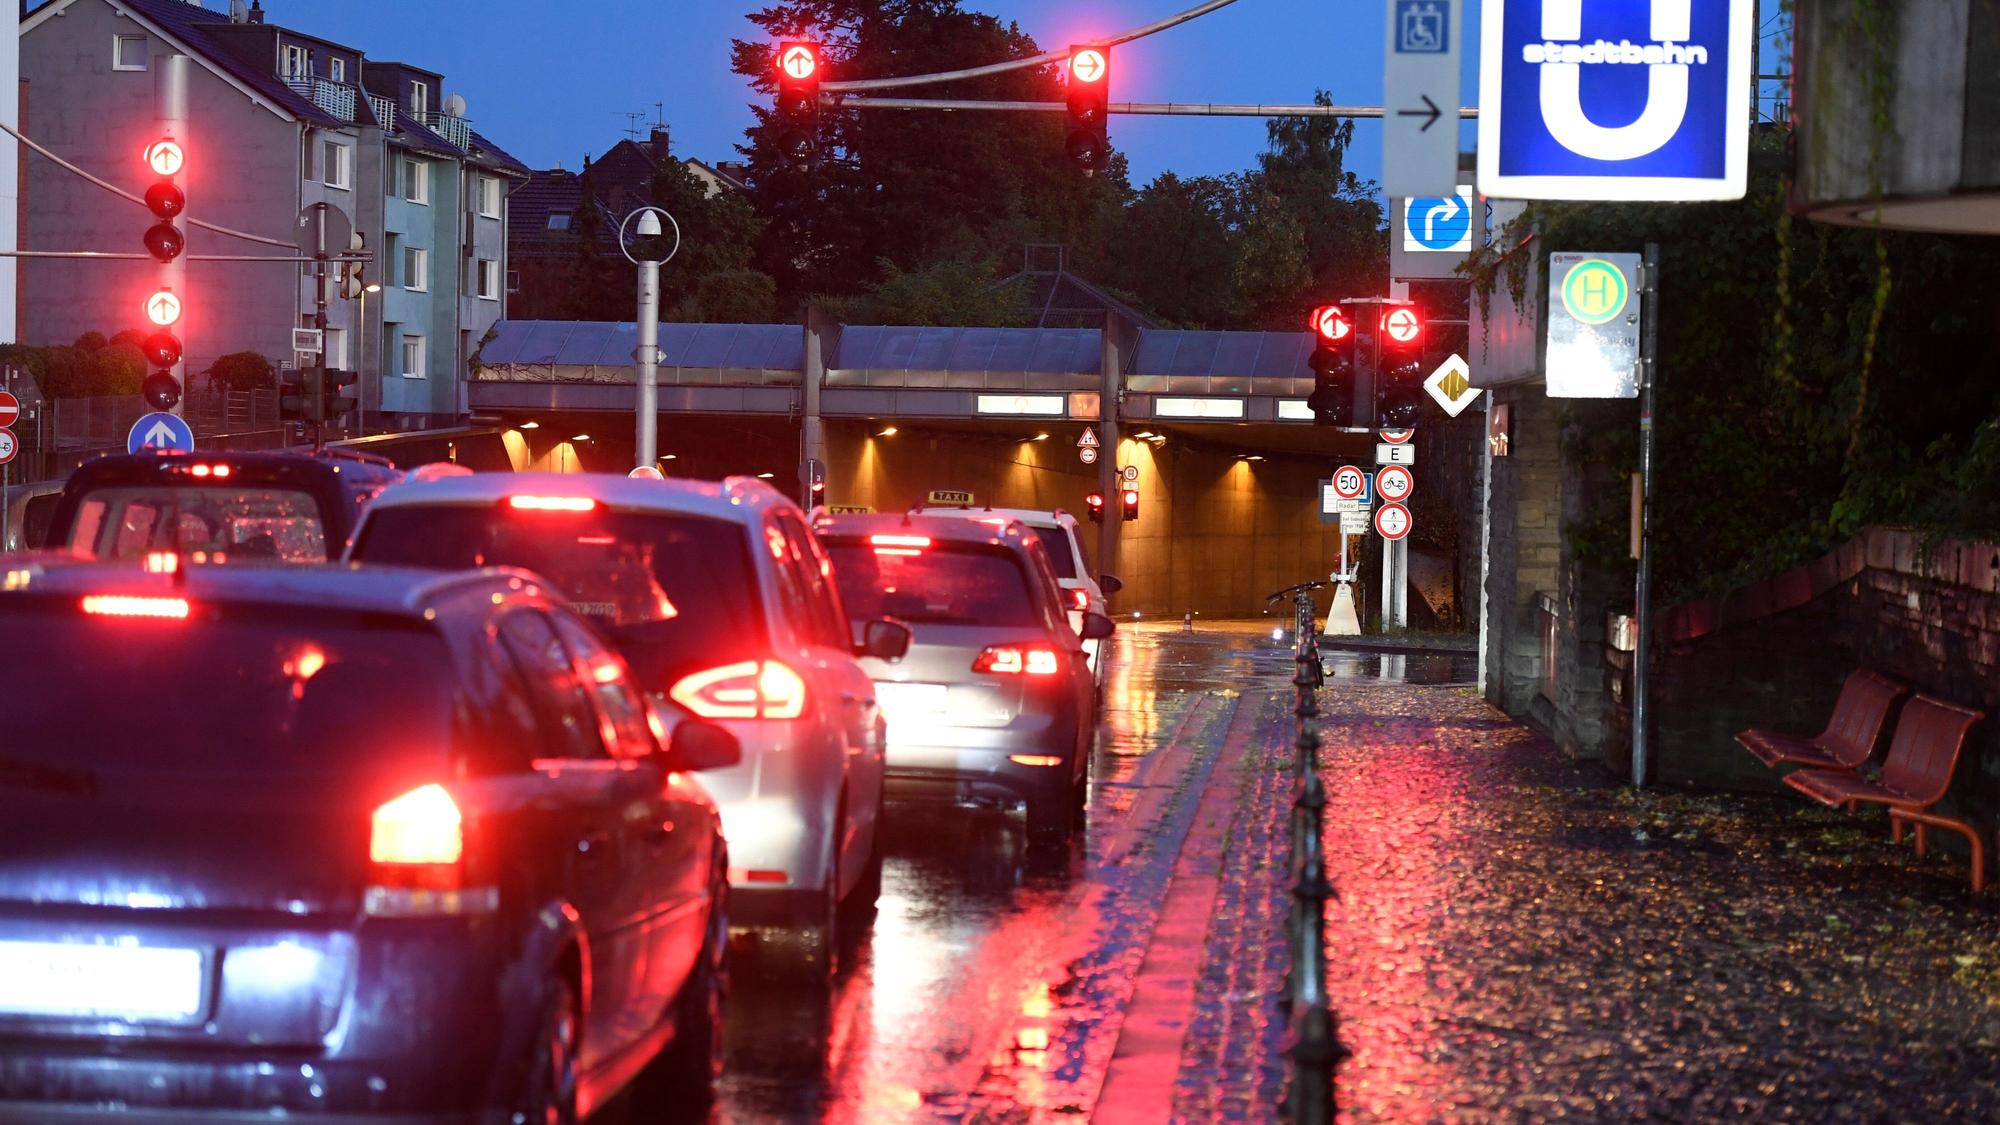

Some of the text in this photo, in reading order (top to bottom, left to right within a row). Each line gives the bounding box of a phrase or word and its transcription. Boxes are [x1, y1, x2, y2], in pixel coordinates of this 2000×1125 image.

[1522, 39, 1708, 65] stadtbahn
[1539, 0, 1690, 161] U
[1583, 275, 1607, 308] H
[1391, 447, 1400, 461] E
[1341, 476, 1358, 490] 50
[938, 492, 966, 501] TAXI
[832, 507, 866, 515] TAXI
